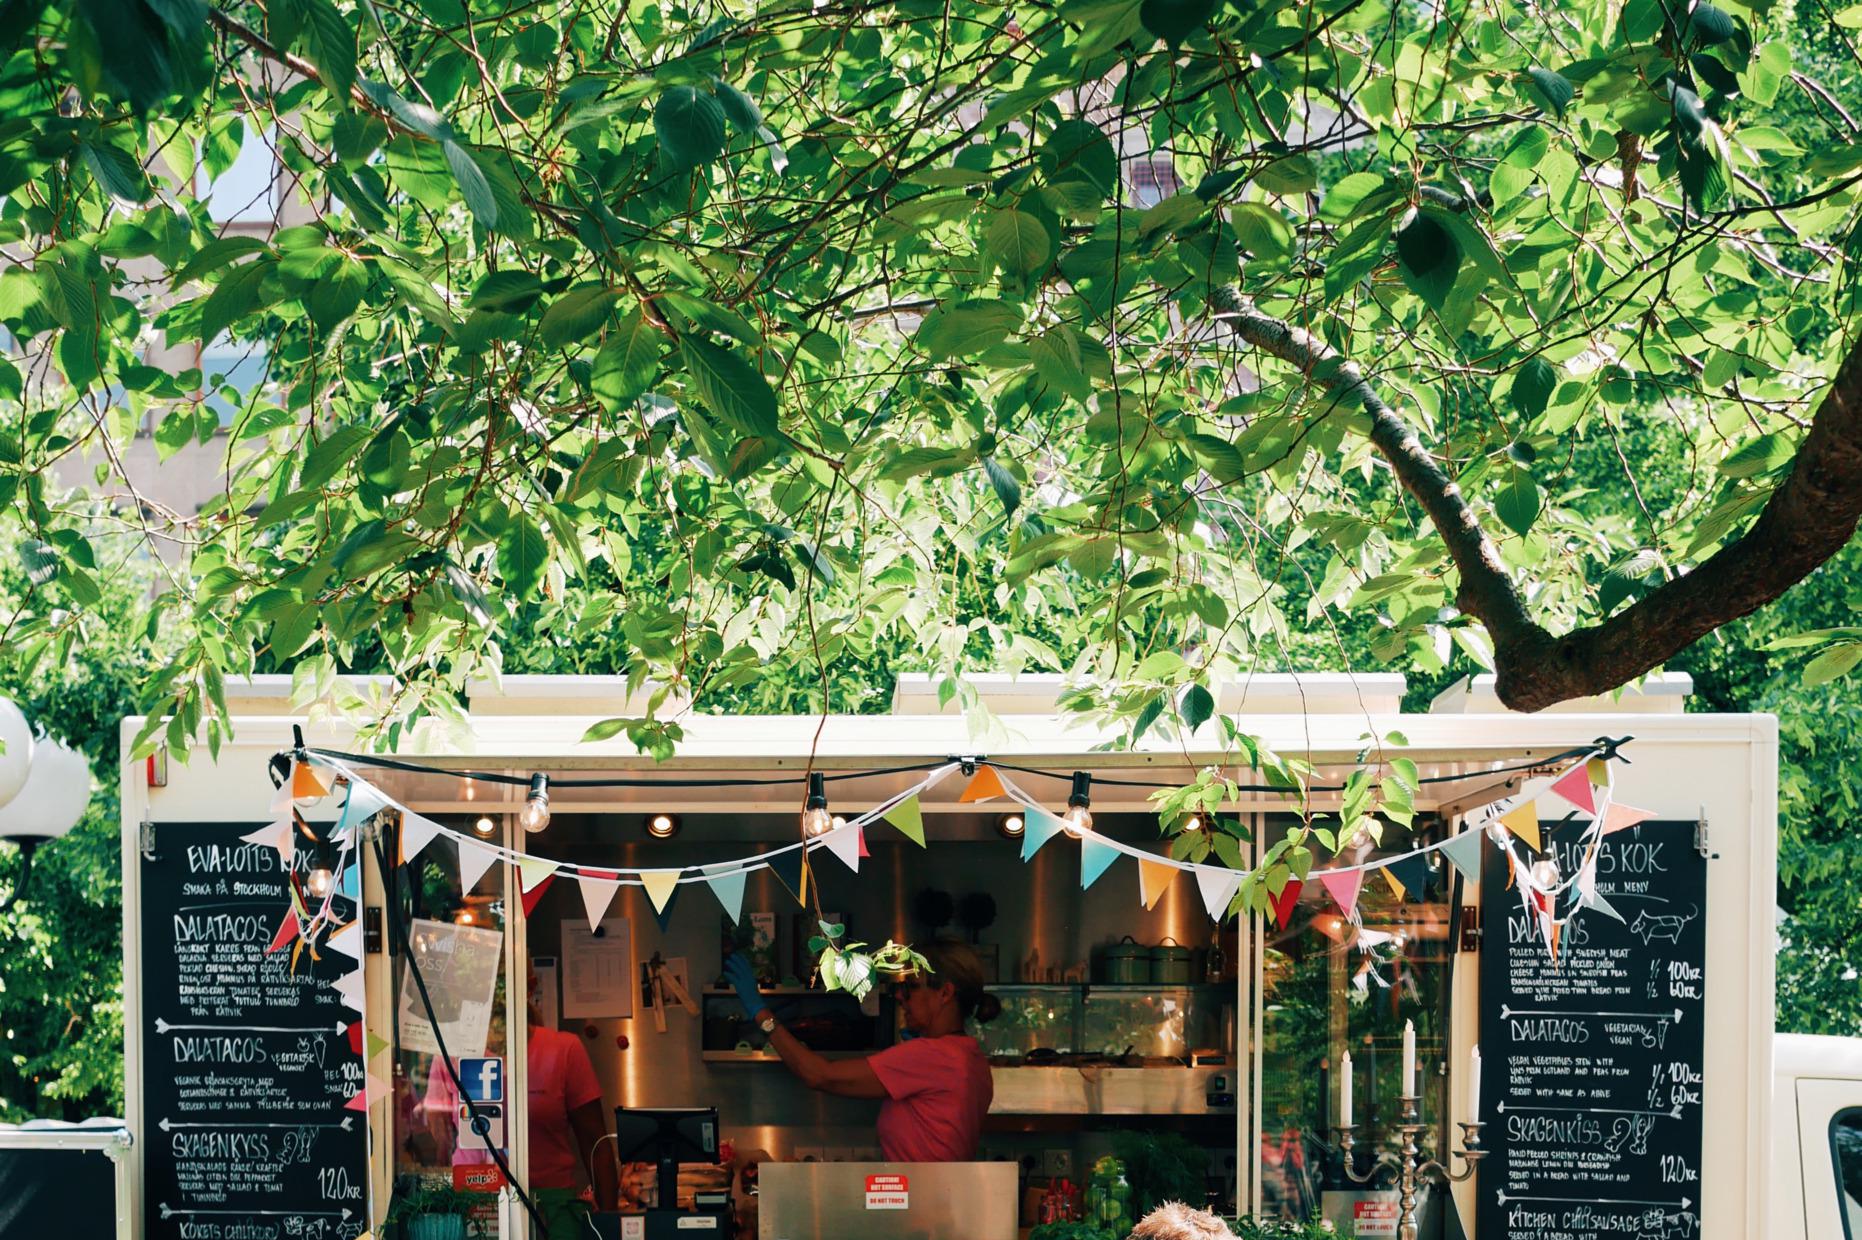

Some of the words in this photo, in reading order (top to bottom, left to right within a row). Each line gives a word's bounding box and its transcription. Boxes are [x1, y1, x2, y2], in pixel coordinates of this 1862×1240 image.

[187, 842, 273, 873] EVA-LOTTS
[1620, 825, 1669, 875] KÖK
[182, 883, 212, 896] SMAKA
[215, 879, 229, 896] PÅ
[233, 882, 282, 897] STOCKHOLM
[1624, 881, 1650, 894] MENY
[174, 914, 271, 943] DALATACOS
[1509, 948, 1535, 957] PULLED
[1575, 948, 1607, 958] SWEDISH
[1609, 948, 1632, 958] MEAT
[1570, 957, 1595, 969] PICKLED
[1510, 968, 1535, 977] CHEESE
[1579, 968, 1608, 977] SWEDISH
[1611, 969, 1628, 977] PEAS
[1667, 960, 1703, 981] 100KR
[1669, 981, 1703, 1000] 60KR
[1510, 1018, 1590, 1043] DALATACOS
[1604, 1022, 1646, 1035] VEGETARIAN
[173, 1037, 267, 1063] DALATACOS
[1609, 1035, 1633, 1046] VEGAN
[1508, 1055, 1530, 1066] VEGAN
[1596, 1058, 1614, 1066] WITH
[1574, 1067, 1589, 1076] AND
[1668, 1062, 1703, 1085] 100KR
[1535, 1088, 1554, 1098] WITH
[1556, 1088, 1574, 1098] SAME
[1577, 1088, 1587, 1098] AS
[1590, 1089, 1612, 1099] ABOVE
[1647, 1087, 1664, 1109] 1/2
[1671, 1084, 1702, 1105] 60KR
[172, 1131, 270, 1160] SKAGENKYSS
[1533, 1171, 1541, 1180] IN
[1543, 1171, 1549, 1179] A
[1572, 1172, 1589, 1181] WITH
[1616, 1173, 1631, 1183] AND
[1660, 1154, 1699, 1183] 120KR
[317, 1166, 363, 1200] 120KR
[466, 1174, 488, 1185] yelp
[1509, 1203, 1556, 1229] KITCHEN
[179, 1214, 222, 1240] KÖKETS
[1508, 1231, 1536, 1240] SERVED
